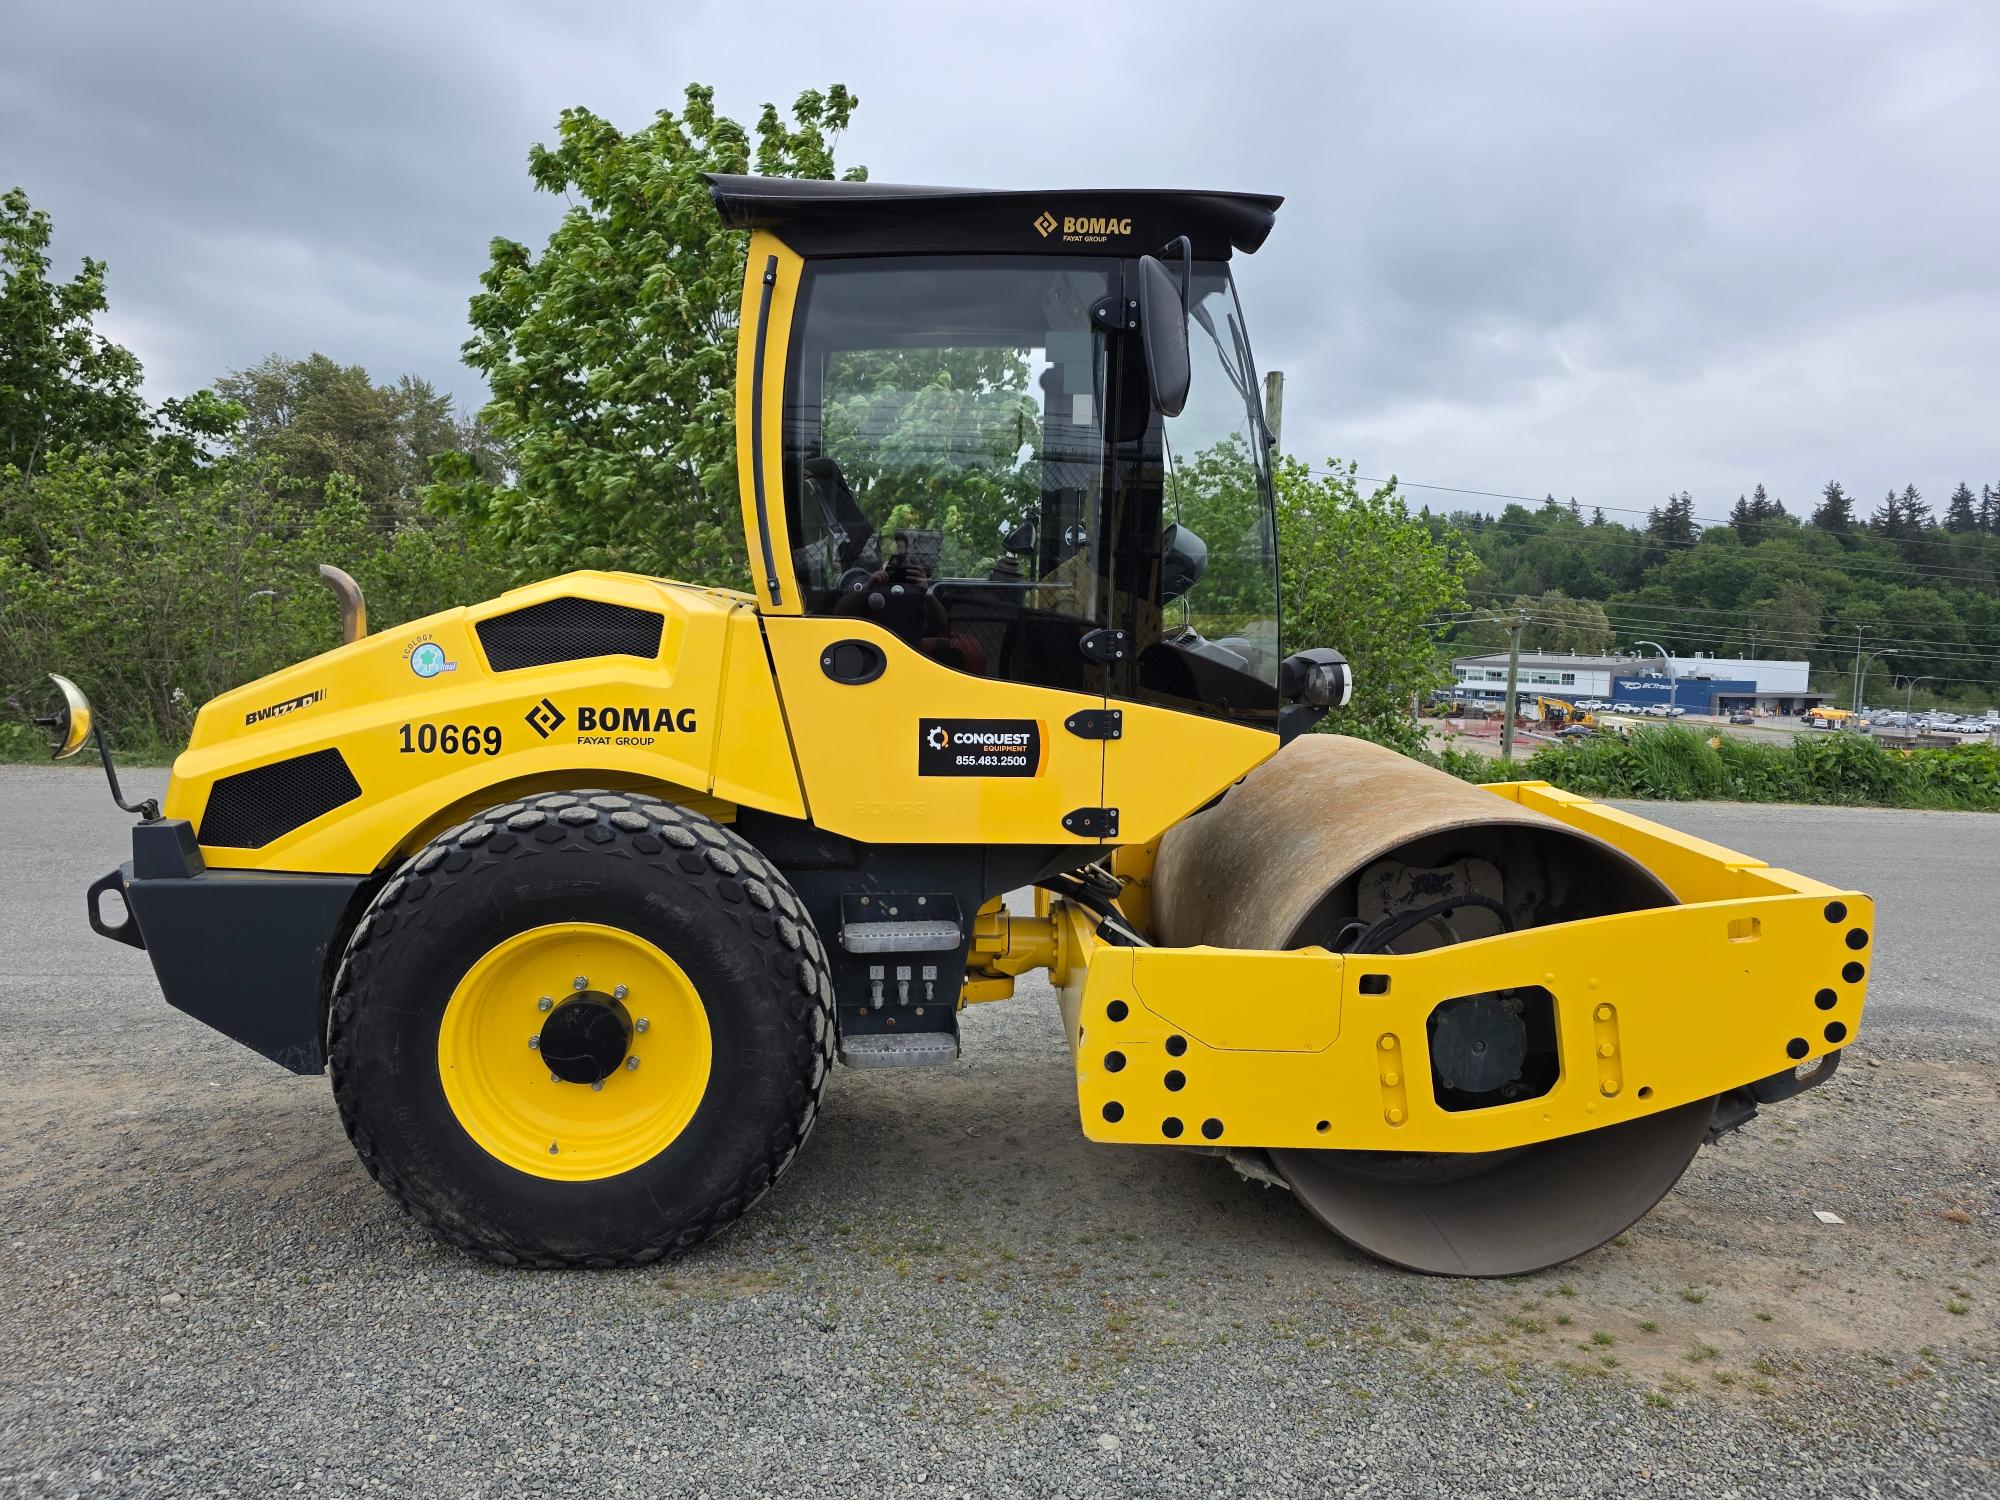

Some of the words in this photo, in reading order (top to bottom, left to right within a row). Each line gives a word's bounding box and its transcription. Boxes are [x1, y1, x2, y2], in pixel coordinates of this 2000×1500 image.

[1063, 216, 1132, 235] BOMAG
[402, 634, 433, 659] ECOLOGY
[577, 706, 697, 733] BOMAG
[400, 723, 502, 756] 10669
[577, 736, 611, 745] FAYAT
[615, 737, 655, 746] GROUP
[953, 732, 1031, 745] CONQUEST
[955, 755, 1027, 766] 855.483.2500
